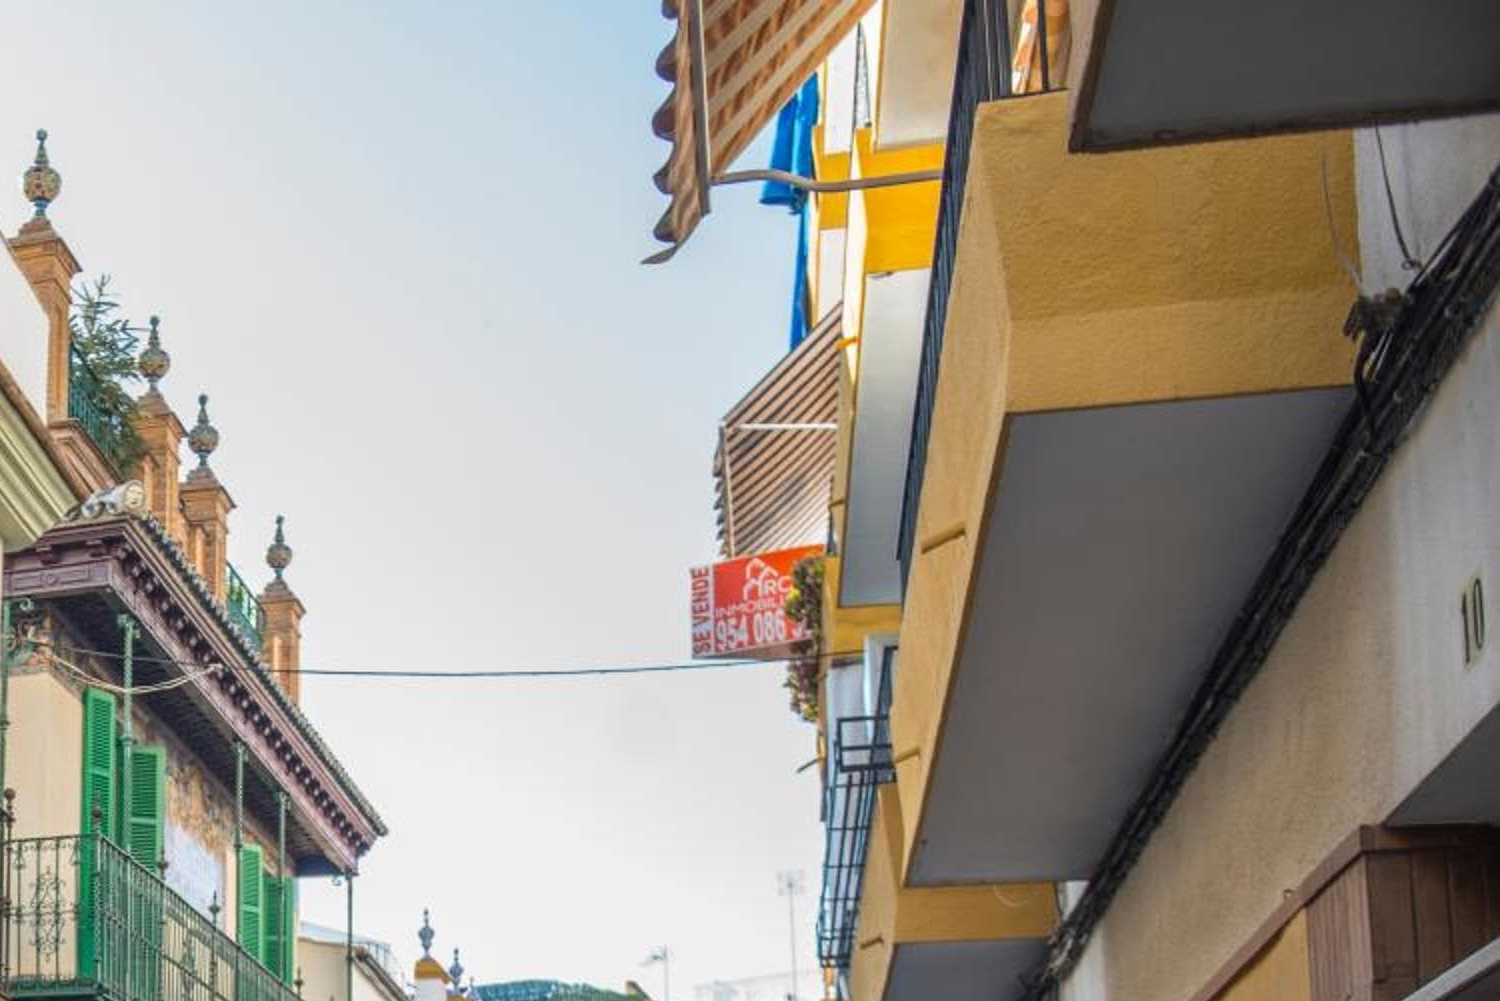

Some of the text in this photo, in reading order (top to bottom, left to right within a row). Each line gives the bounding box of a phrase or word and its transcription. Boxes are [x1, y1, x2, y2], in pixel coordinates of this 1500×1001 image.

[691, 567, 710, 654] SE VENDE
[716, 614, 749, 650] 954
[753, 608, 787, 644] 086
